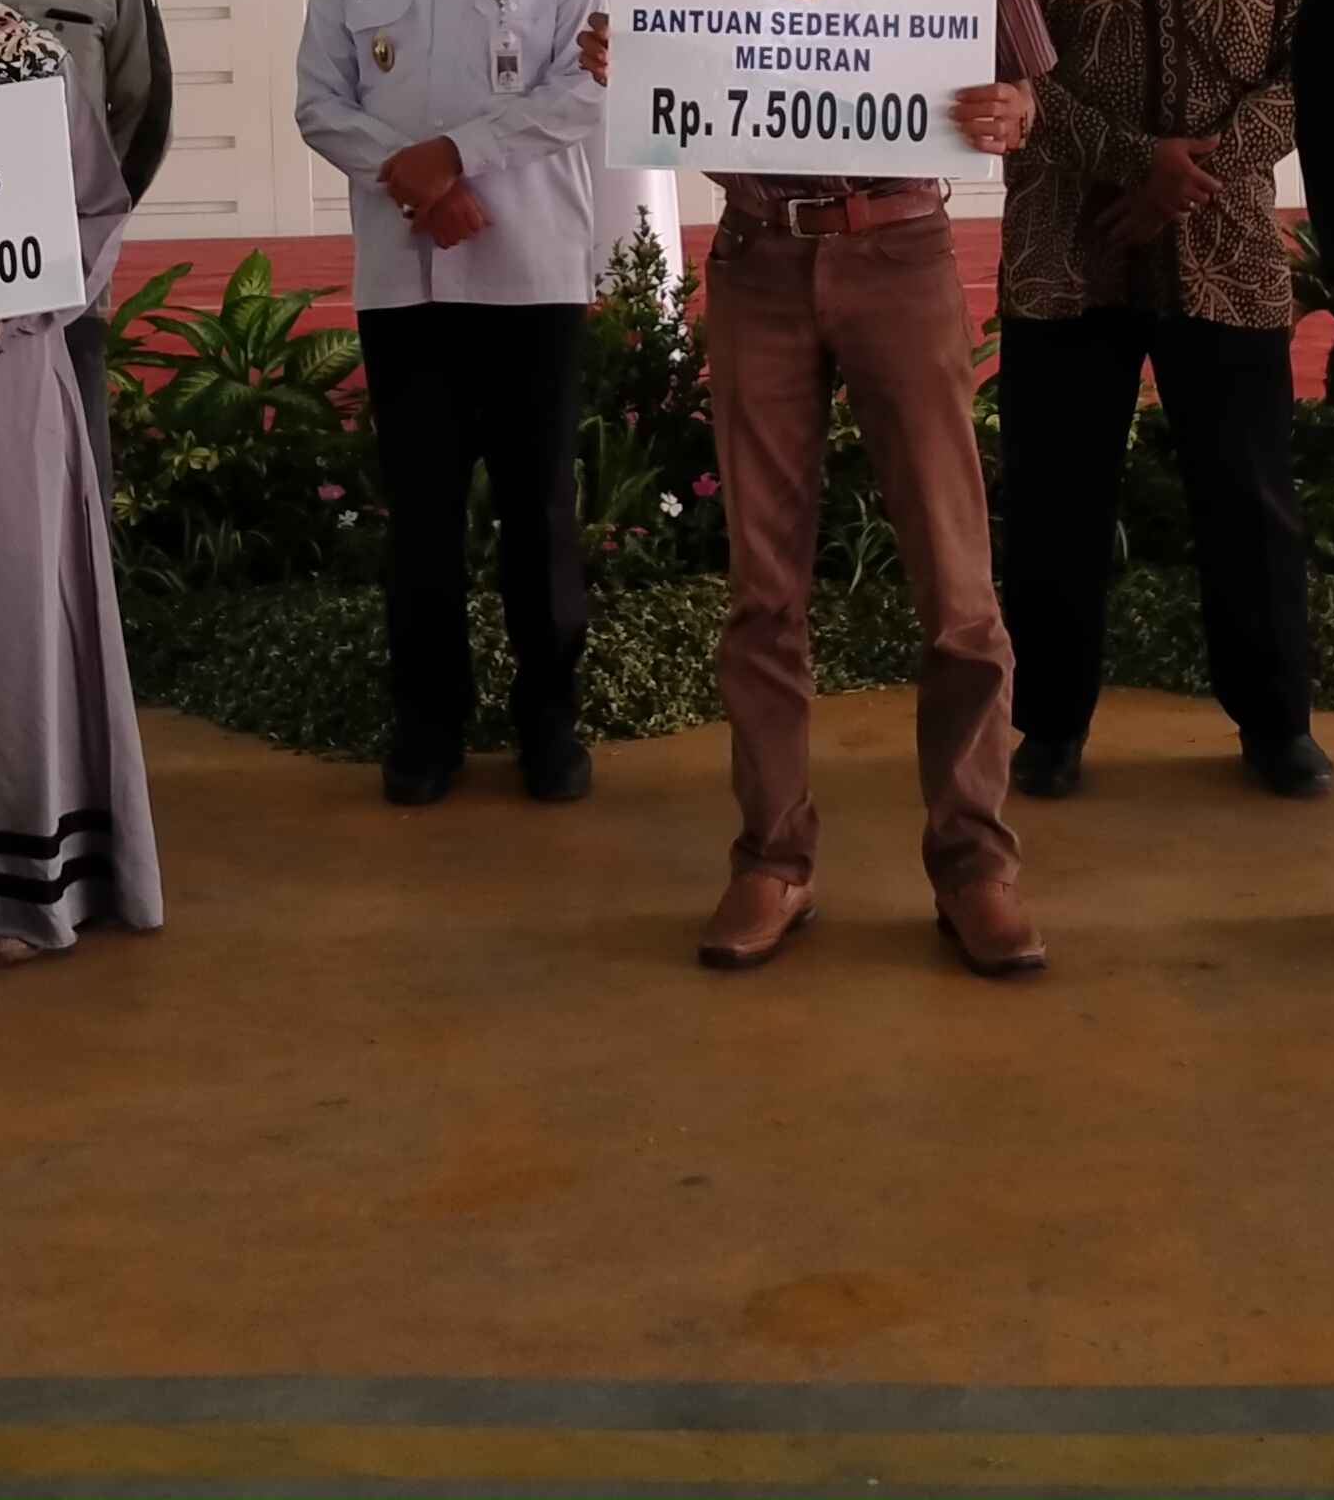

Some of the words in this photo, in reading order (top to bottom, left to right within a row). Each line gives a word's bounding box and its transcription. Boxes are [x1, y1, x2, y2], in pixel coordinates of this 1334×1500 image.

[633, 9, 761, 35] BANTUAN
[771, 11, 899, 38] SEDEKAH
[910, 14, 978, 39] BUMI
[736, 46, 870, 71] MEDURAN
[653, 88, 713, 147] Rp.
[728, 89, 928, 142] 7.500.000
